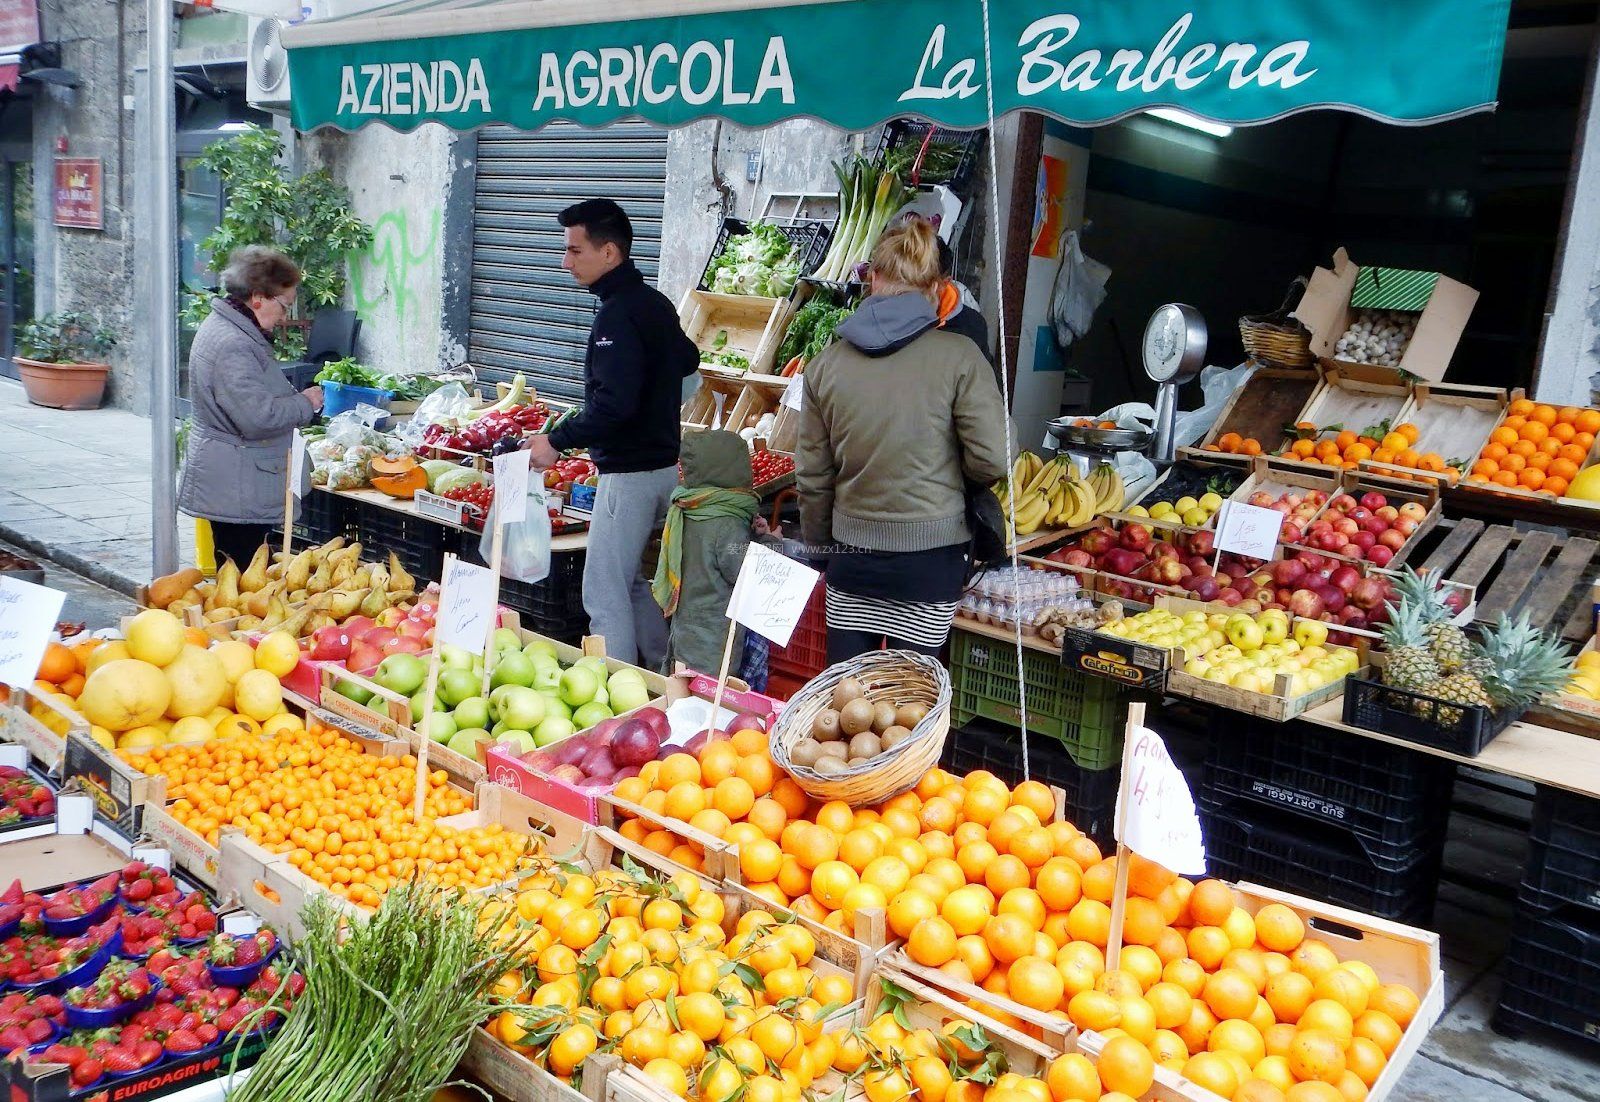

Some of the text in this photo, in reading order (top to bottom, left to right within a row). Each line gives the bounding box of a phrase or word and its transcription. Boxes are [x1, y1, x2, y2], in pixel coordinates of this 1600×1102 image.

[336, 12, 1319, 116] AZIENDA AGRICOLA La Barbera
[1267, 789, 1316, 810] ORTAGGI
[1321, 805, 1345, 819] SUD
[113, 1062, 200, 1101] EUROAGRI
